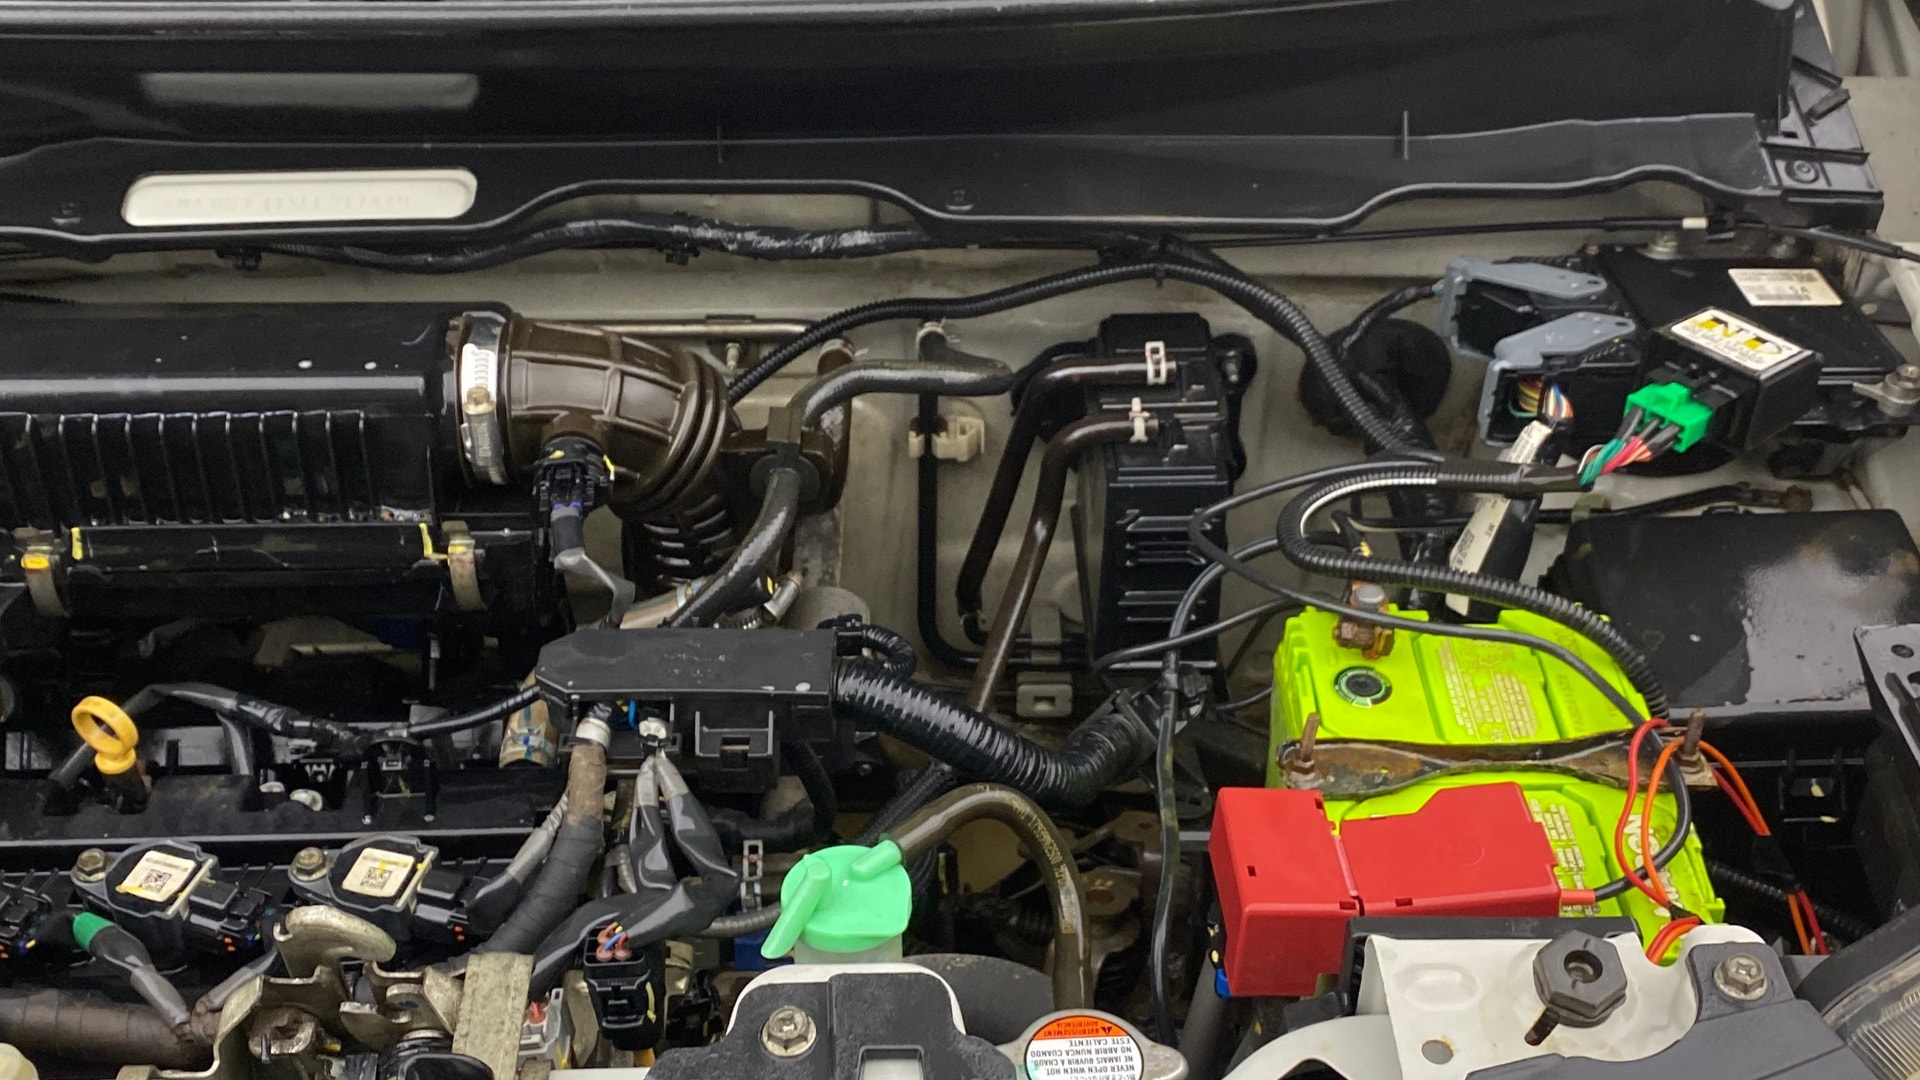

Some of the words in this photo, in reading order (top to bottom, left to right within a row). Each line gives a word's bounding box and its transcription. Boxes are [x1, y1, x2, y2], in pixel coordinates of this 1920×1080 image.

[1043, 1028, 1099, 1036] AVERTISSEMENT
[1030, 1049, 1063, 1057] CUANDO
[1065, 1048, 1092, 1056] NUNCA
[1095, 1046, 1118, 1054] ABRIR
[1121, 1046, 1132, 1054] NO
[1096, 1056, 1121, 1064] JAMAIS
[1124, 1055, 1134, 1063] NE
[1110, 1064, 1135, 1072] NEVER
